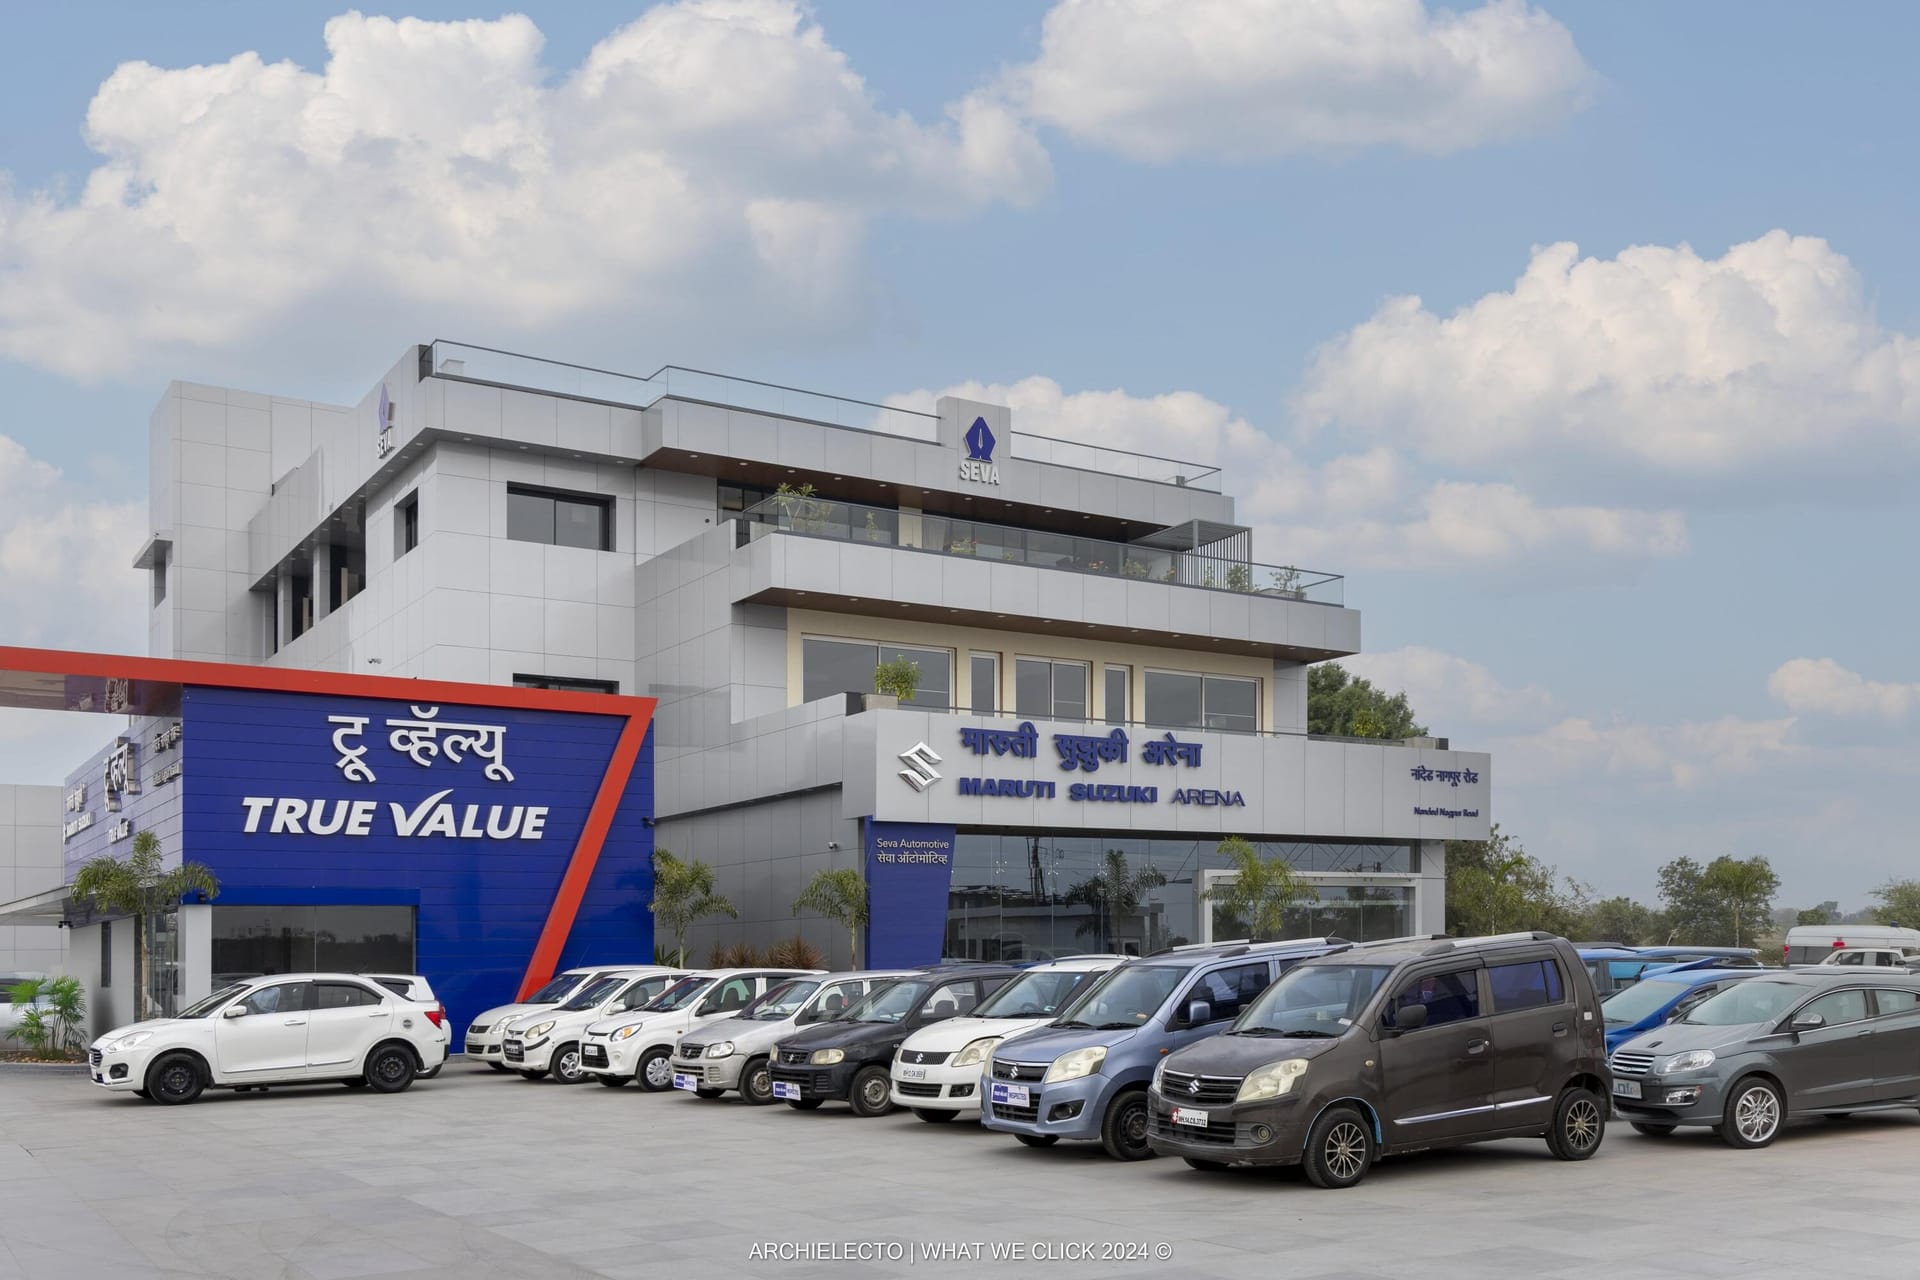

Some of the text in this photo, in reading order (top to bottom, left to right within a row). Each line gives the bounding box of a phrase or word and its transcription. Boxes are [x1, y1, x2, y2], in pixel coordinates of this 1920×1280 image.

[960, 460, 1000, 485] SEVA
[328, 705, 515, 783] ट्रू व्हॅल्यू
[960, 721, 1203, 772] मारुती सुझुकी अरेना
[959, 777, 1246, 807] MARUTI SUZUKI ARENA
[242, 788, 549, 839] TRUE VALUE
[876, 838, 949, 849] Seva Automotive
[876, 850, 895, 863] सेवा
